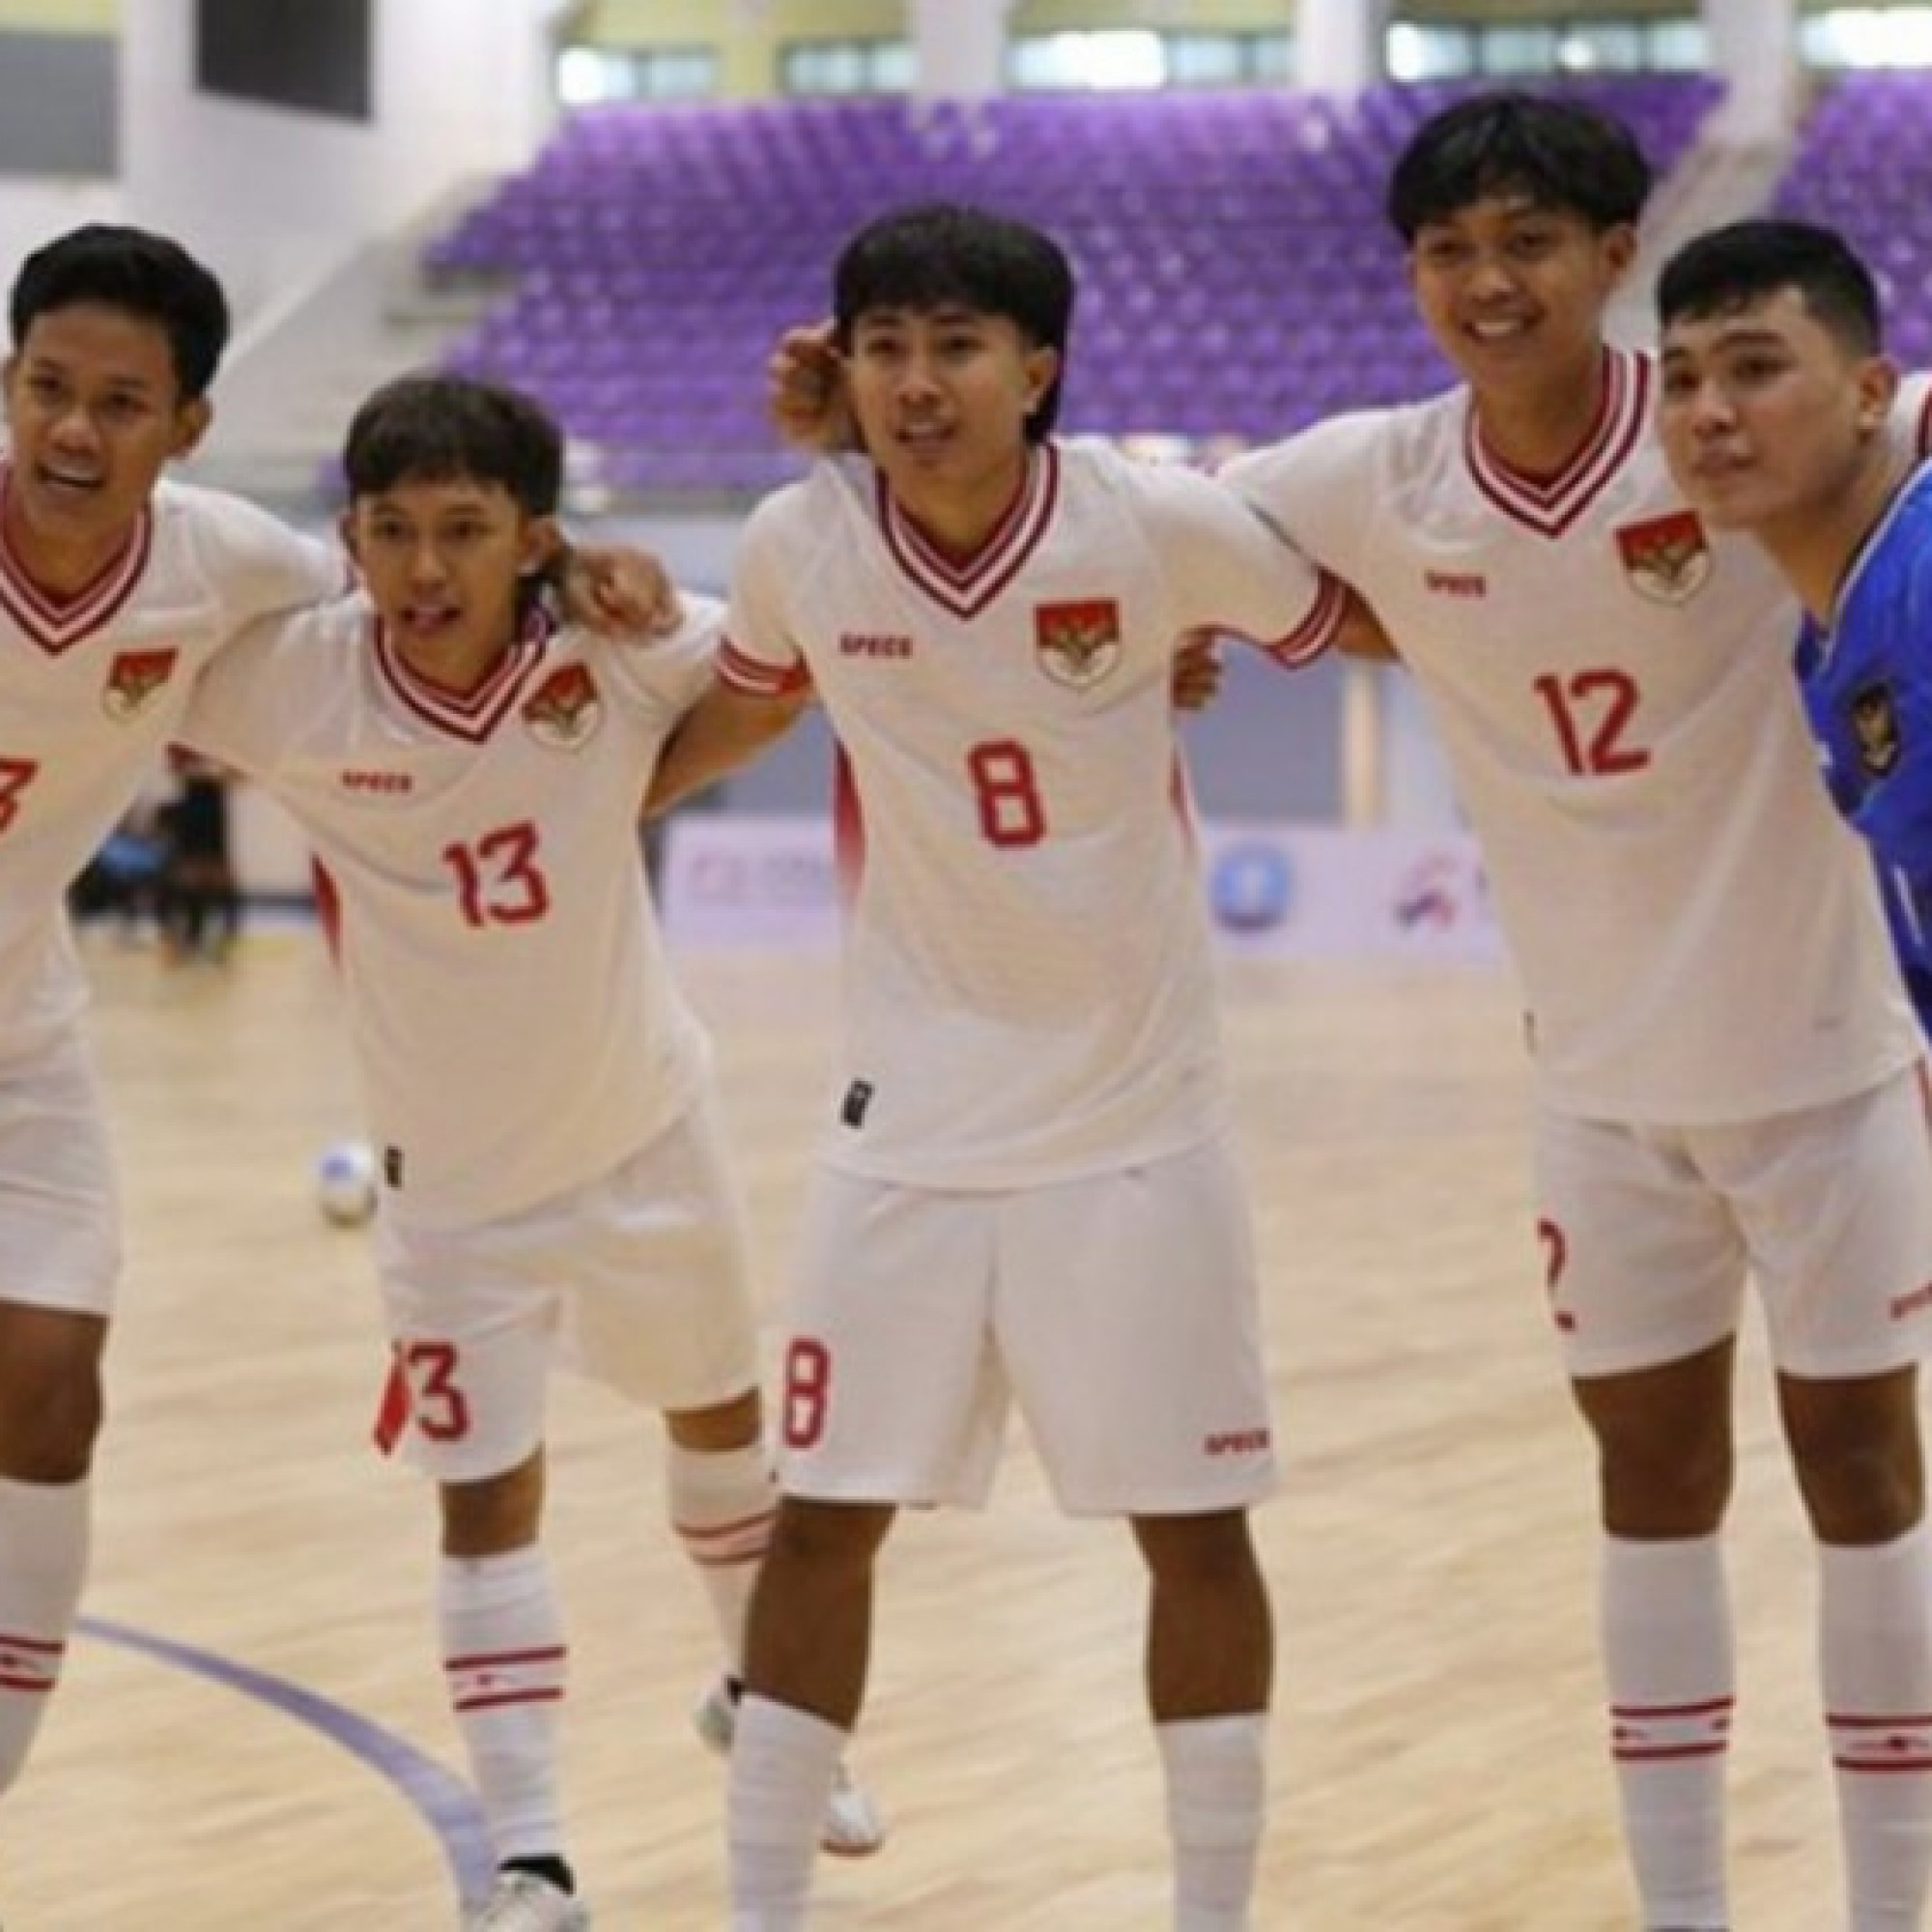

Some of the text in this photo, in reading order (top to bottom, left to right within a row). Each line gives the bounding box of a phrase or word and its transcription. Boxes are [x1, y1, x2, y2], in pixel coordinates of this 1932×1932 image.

[1533, 668, 1650, 777] 12
[967, 740, 1047, 850] 8
[442, 819, 550, 927] 13
[783, 1339, 831, 1449] 8
